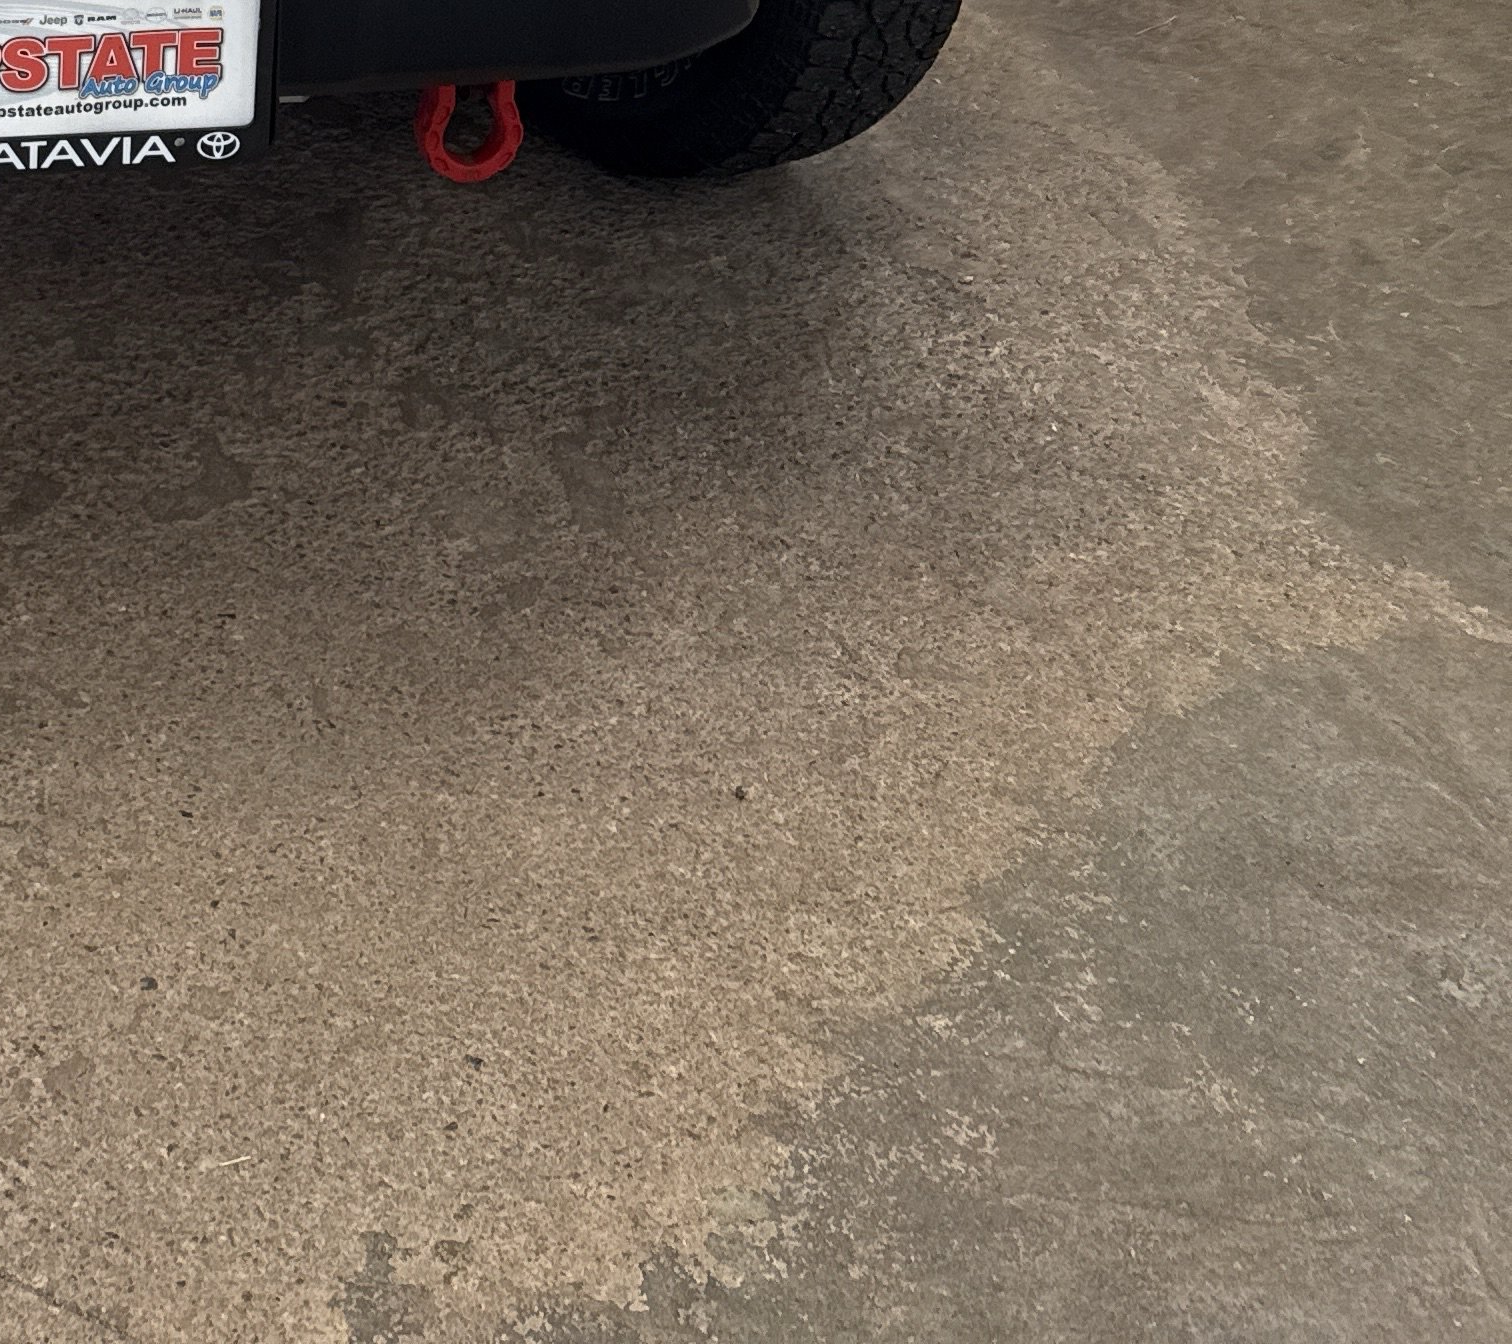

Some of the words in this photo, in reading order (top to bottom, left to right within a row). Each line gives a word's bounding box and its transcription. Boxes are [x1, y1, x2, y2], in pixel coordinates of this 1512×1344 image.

[39, 14, 68, 26] Jeep
[79, 75, 139, 99] Auto
[144, 71, 220, 99] Group
